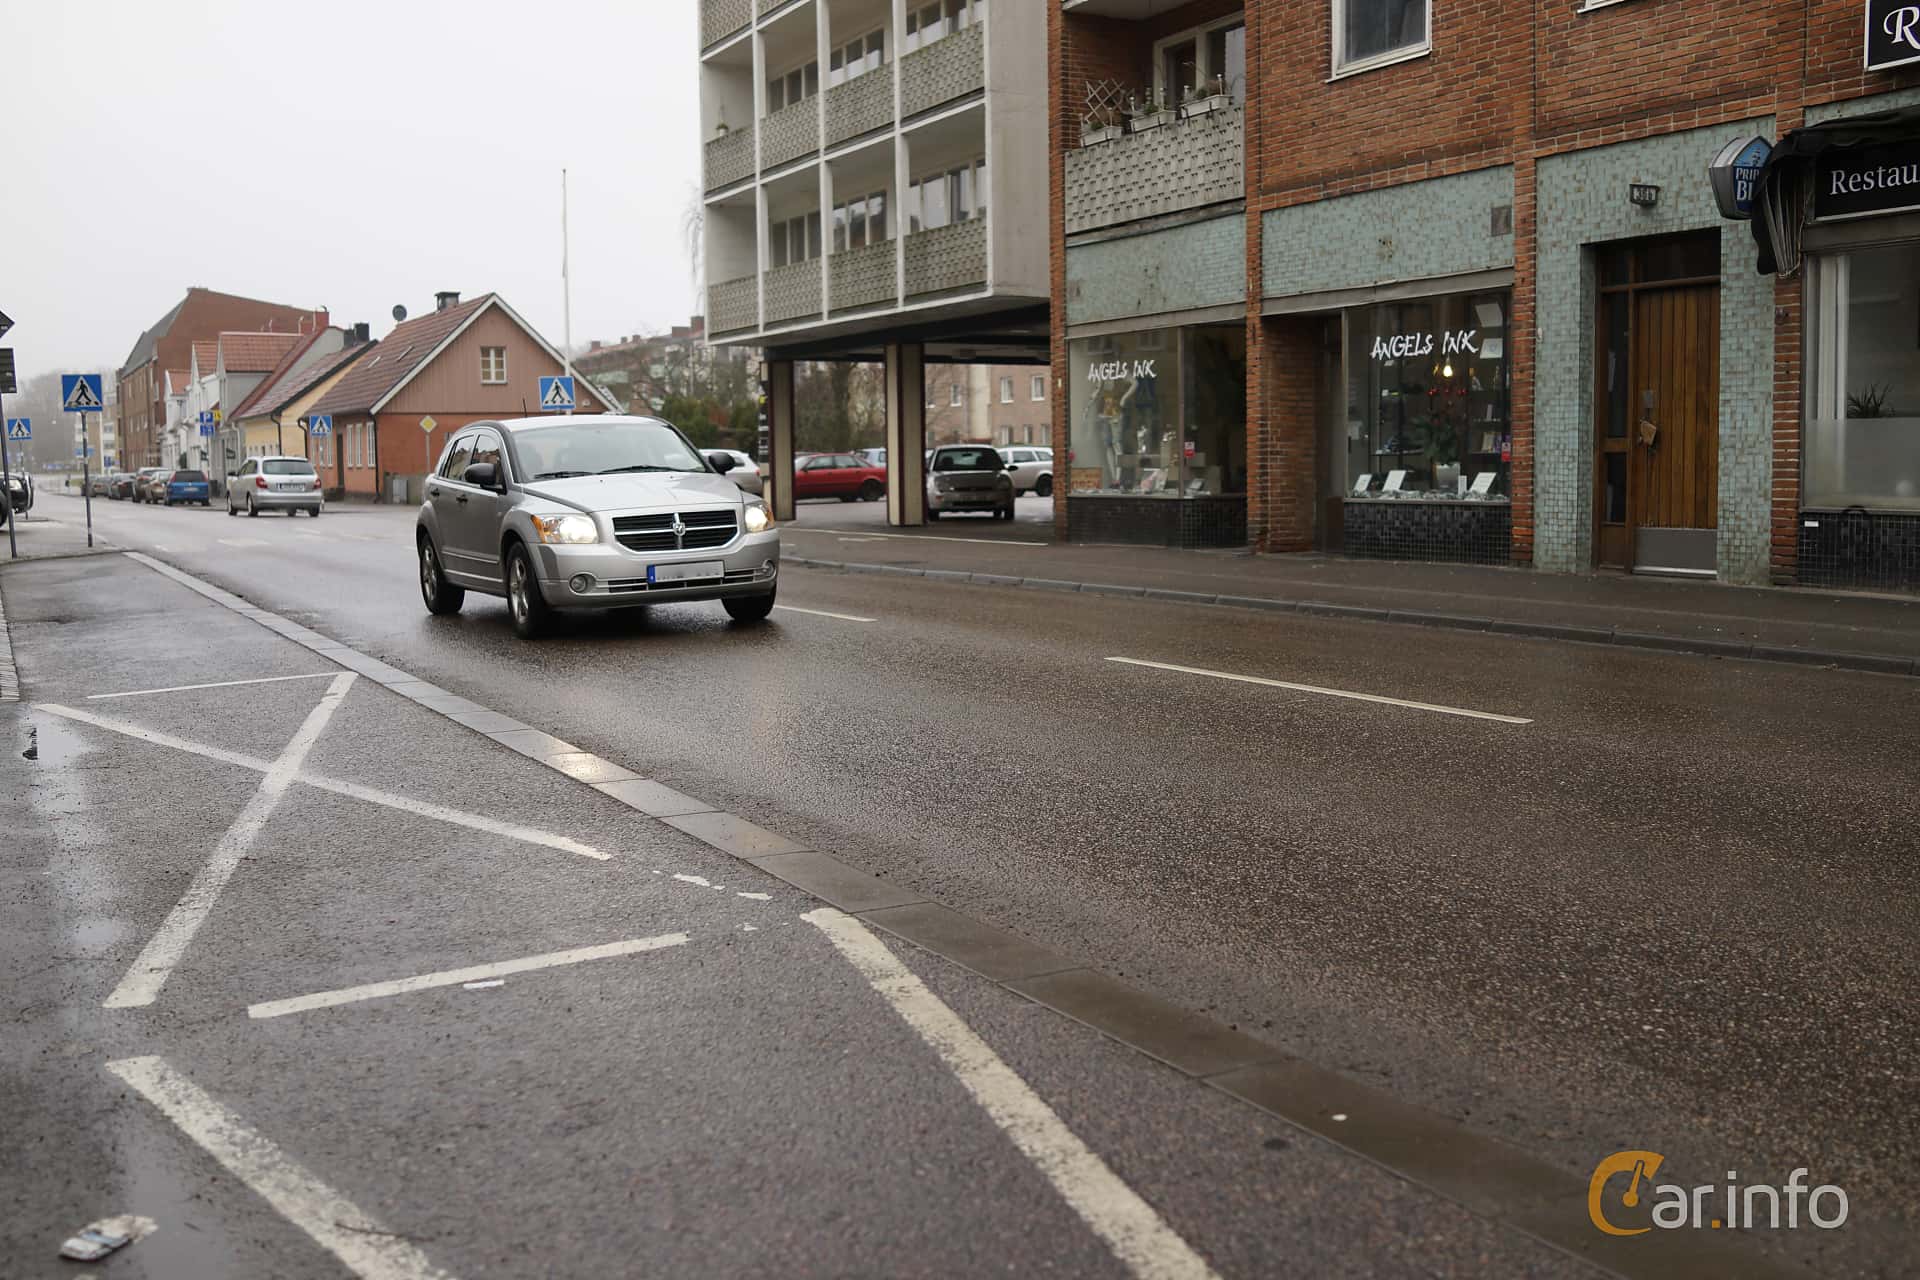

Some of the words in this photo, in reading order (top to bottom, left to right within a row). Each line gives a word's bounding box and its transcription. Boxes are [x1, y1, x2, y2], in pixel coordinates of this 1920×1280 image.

[1883, 6, 1920, 50] R
[1369, 331, 1434, 360] ANGELS
[1442, 329, 1479, 354] INK
[1087, 360, 1128, 382] ANGELS
[1132, 359, 1157, 378] INK
